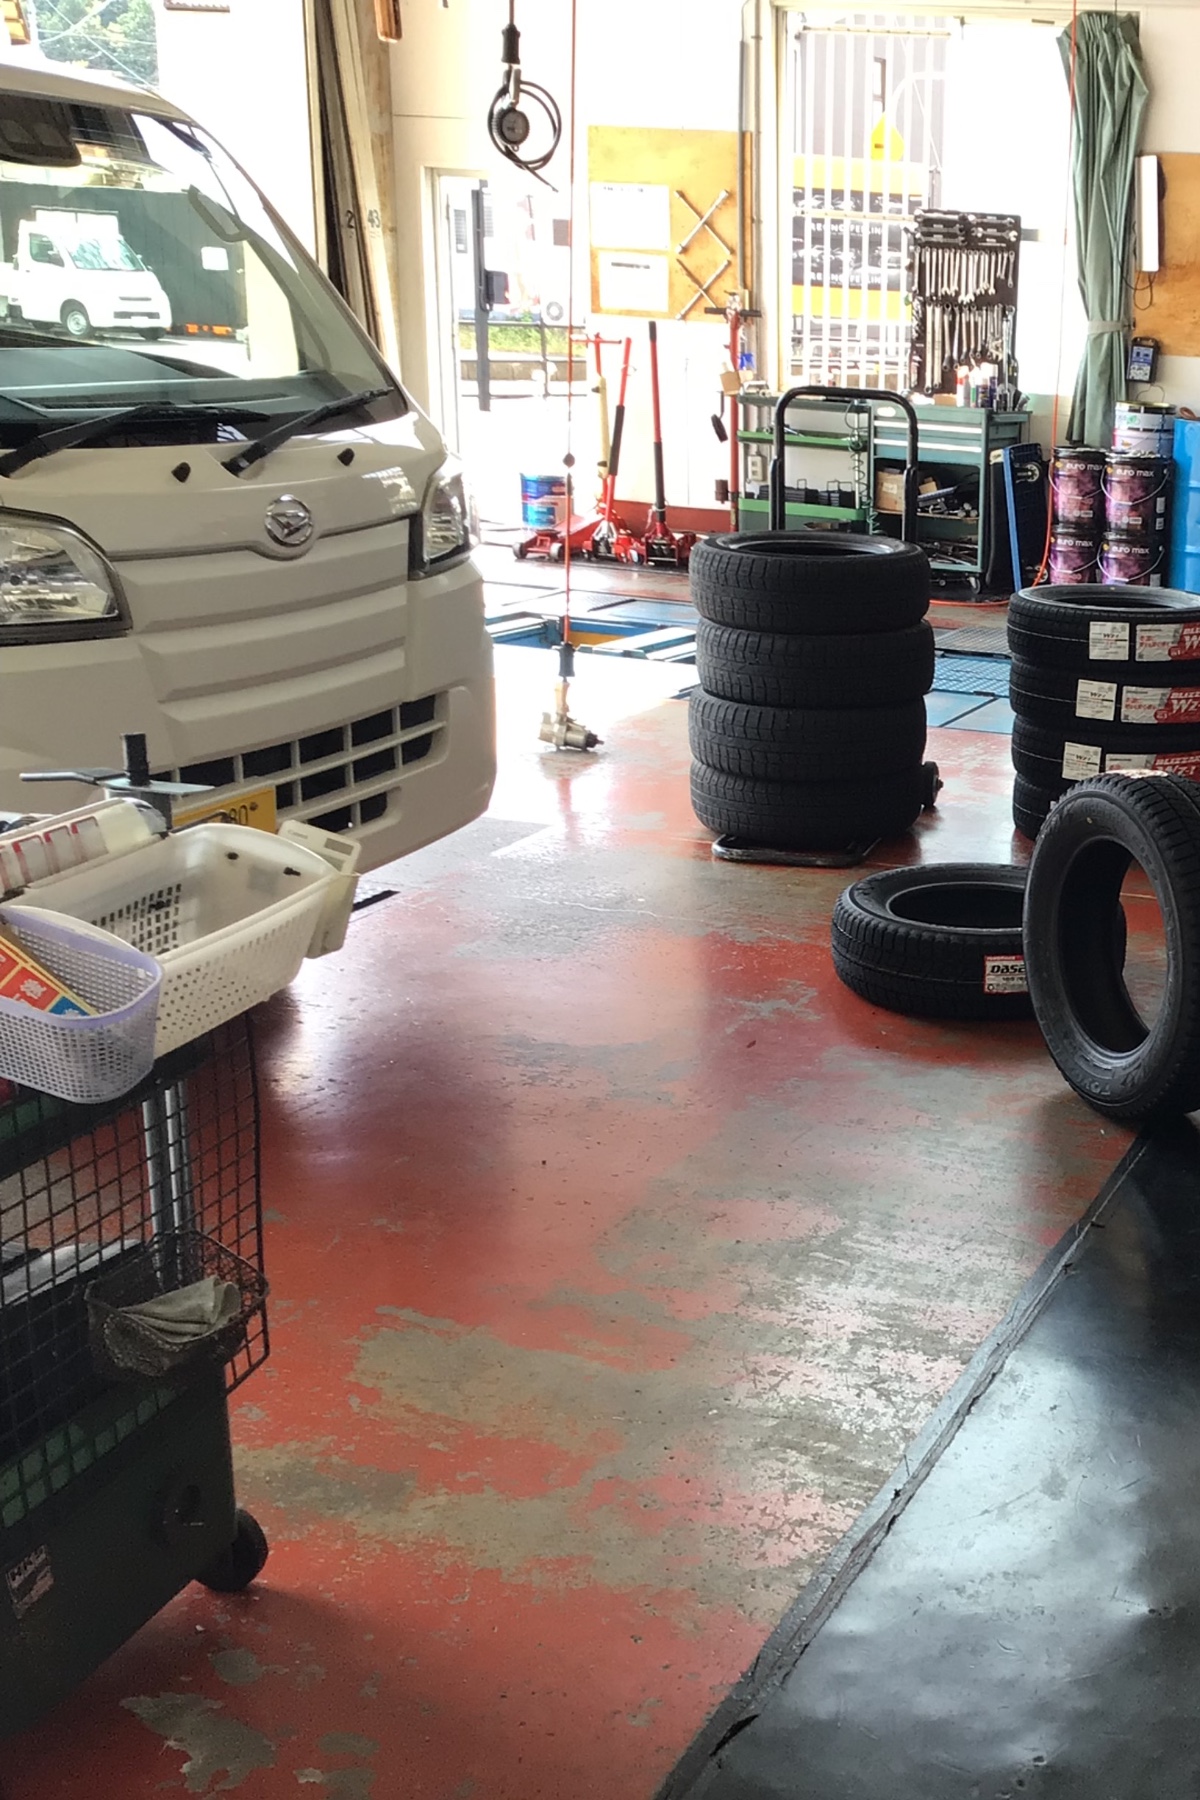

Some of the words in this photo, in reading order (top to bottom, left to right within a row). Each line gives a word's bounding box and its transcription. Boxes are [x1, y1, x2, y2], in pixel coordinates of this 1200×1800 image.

[345, 209, 355, 229] 2
[367, 209, 381, 228] 43
[1116, 468, 1135, 477] euro
[1136, 469, 1155, 478] max
[1057, 538, 1074, 547] euro
[1075, 539, 1093, 548] max
[1111, 546, 1131, 554] euro
[1132, 546, 1150, 555] max
